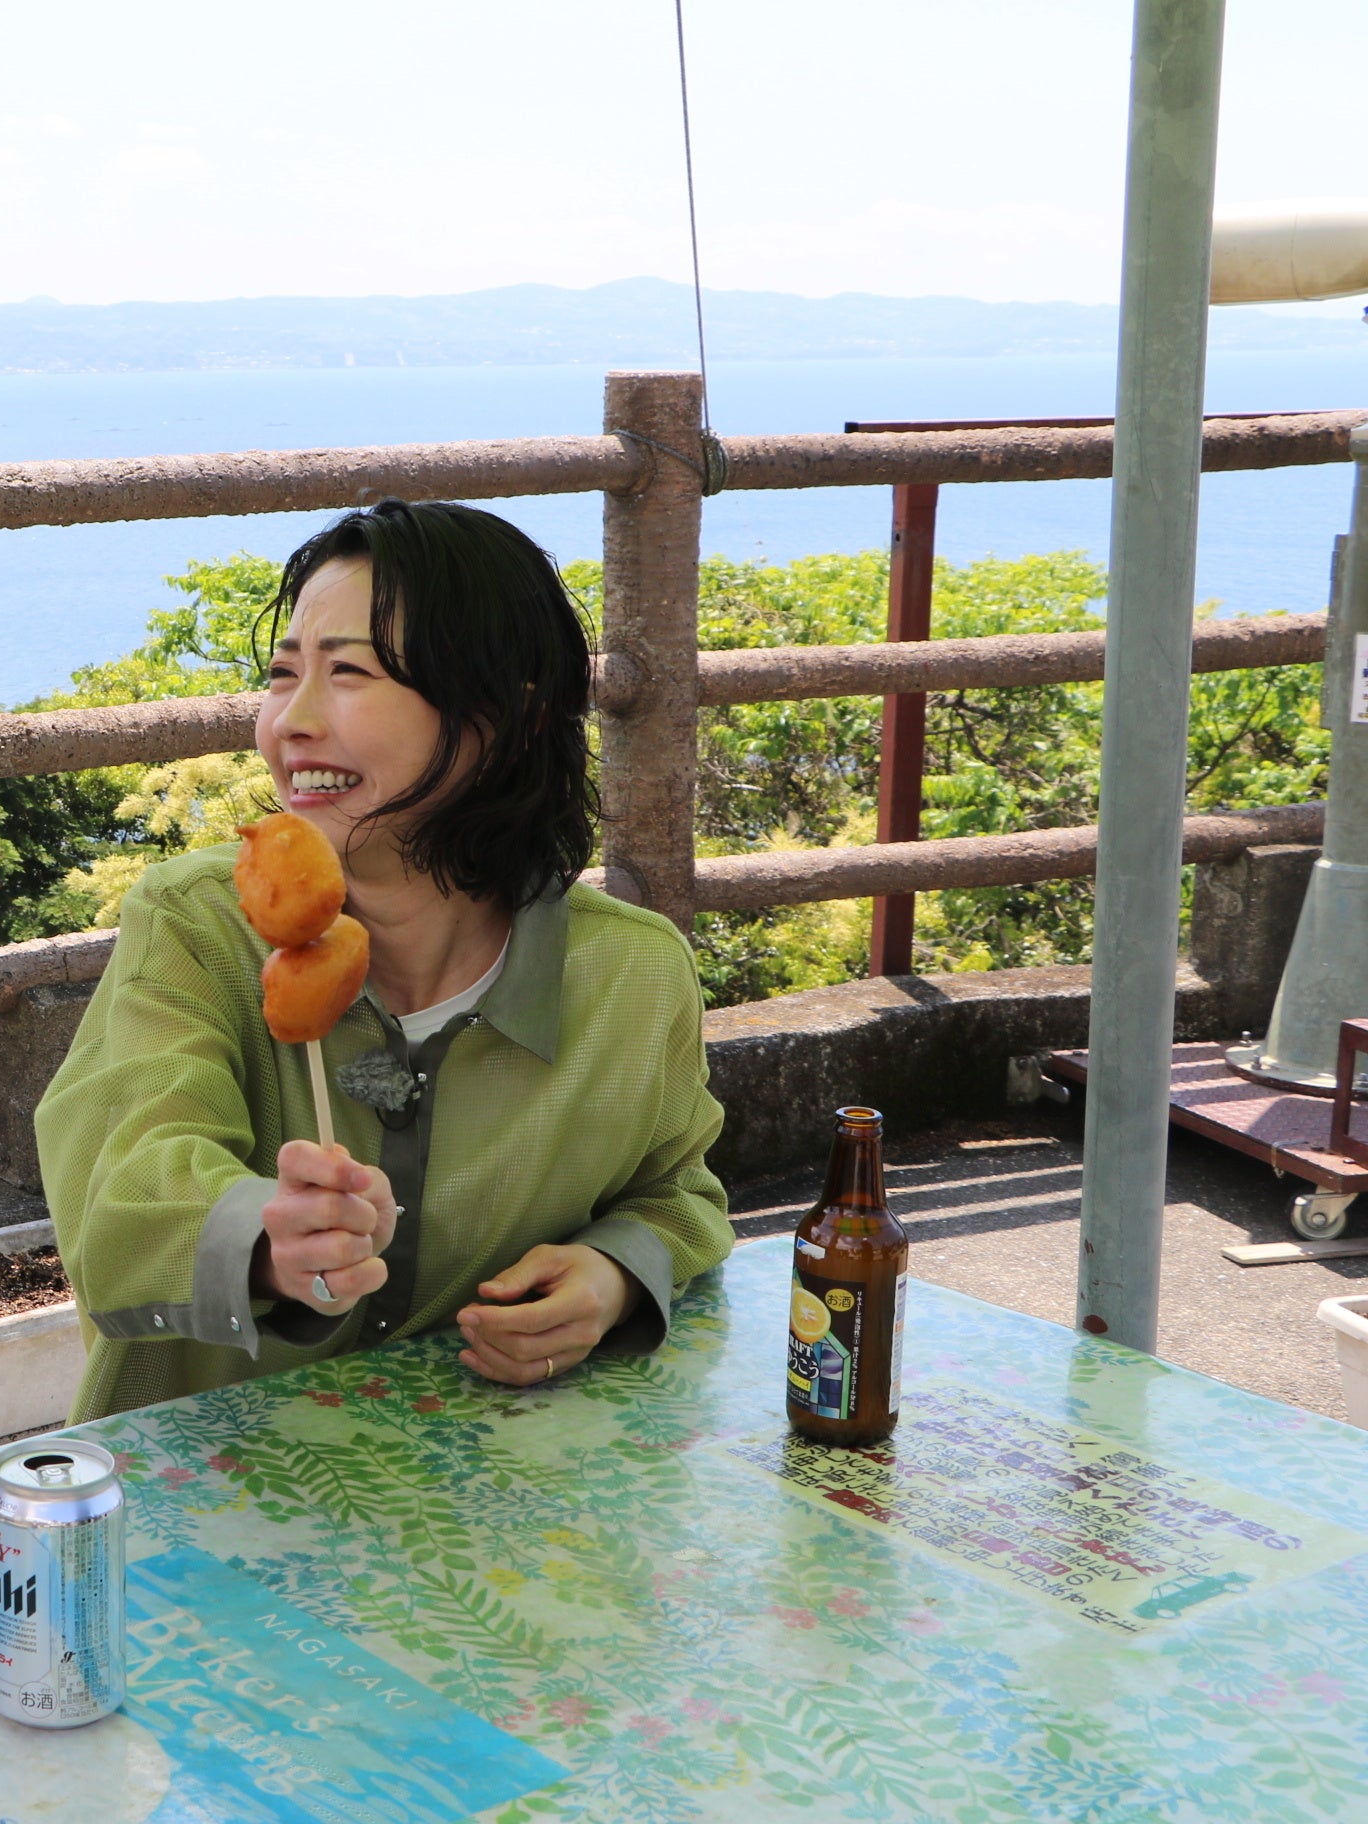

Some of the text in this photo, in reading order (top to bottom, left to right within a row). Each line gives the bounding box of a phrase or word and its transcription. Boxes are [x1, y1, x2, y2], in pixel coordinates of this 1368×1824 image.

[826, 1294, 851, 1309] お酒
[789, 1335, 813, 1358] RAFT
[1077, 1605, 1146, 1634] 店主
[254, 1612, 419, 1712] NAGASAKI
[21, 1691, 53, 1710] お酒
[125, 1654, 325, 1796] Meeting
